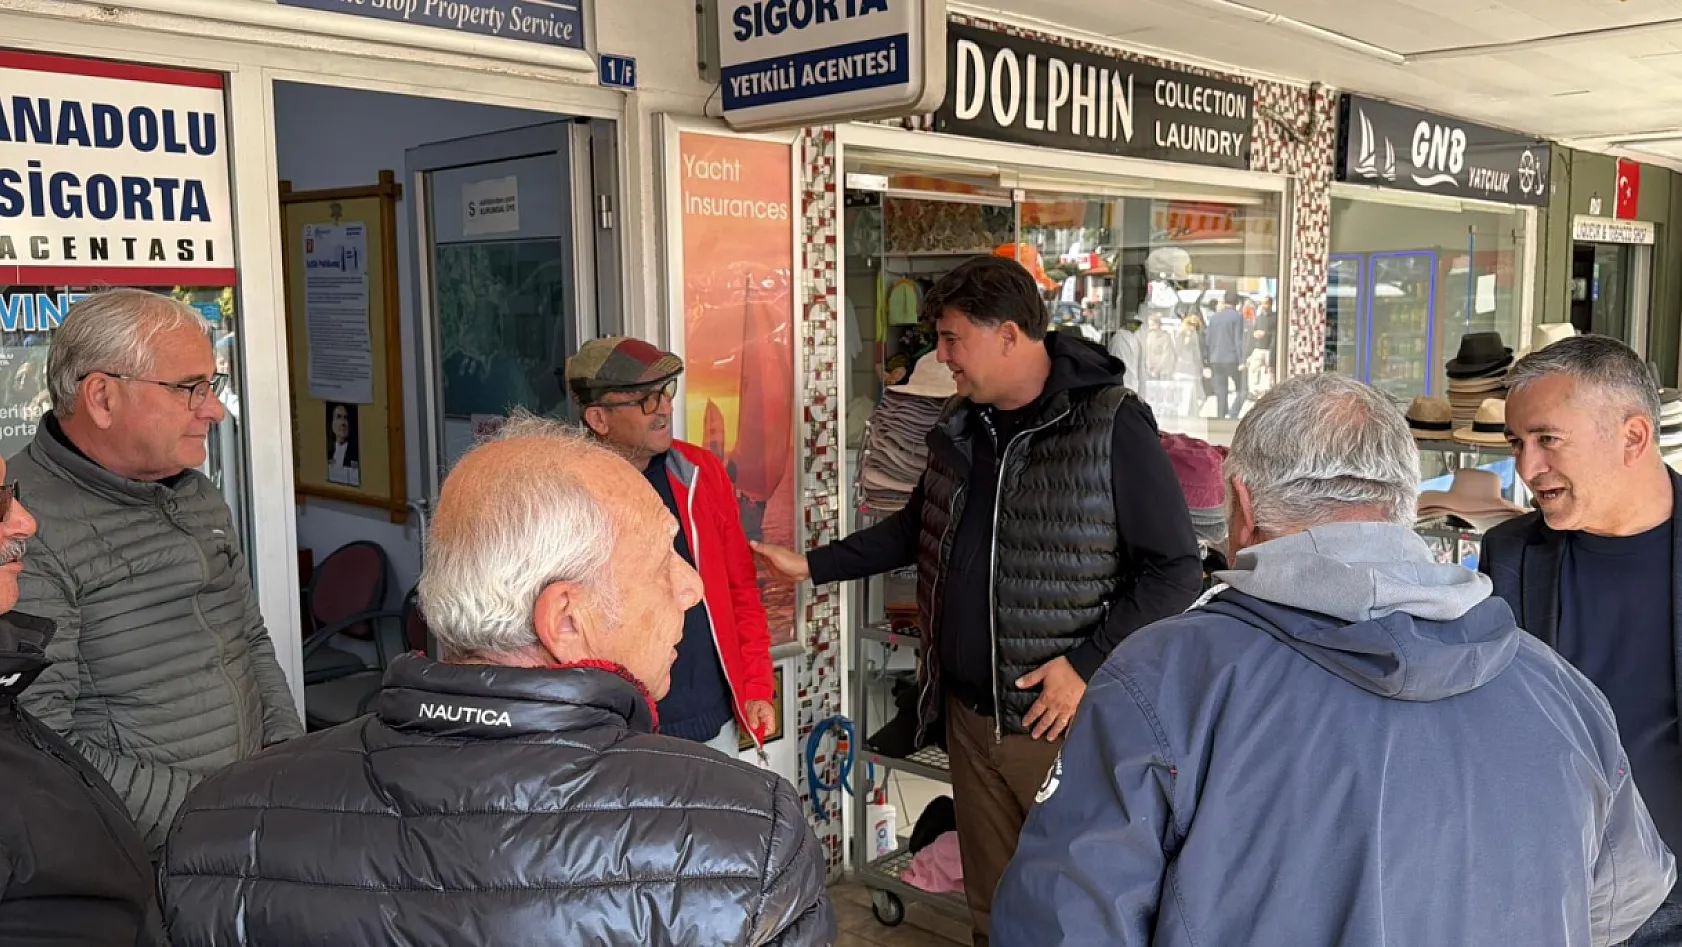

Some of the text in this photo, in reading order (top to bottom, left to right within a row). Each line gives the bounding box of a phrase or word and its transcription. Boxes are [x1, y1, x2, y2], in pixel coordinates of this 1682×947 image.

[423, 0, 505, 34] Property
[509, 7, 573, 41] Service
[730, 43, 897, 98] YETKİLİ ACENTESİ
[955, 39, 1135, 143] DOLPHIN
[1155, 79, 1247, 119] COLLECTION
[1155, 120, 1244, 157] LAUNDRY
[1411, 120, 1467, 174] GNB
[683, 153, 743, 181] Yacht
[0, 160, 212, 222] SİGORTA
[685, 191, 789, 220] Insurances
[419, 703, 512, 727] NAUTICA
